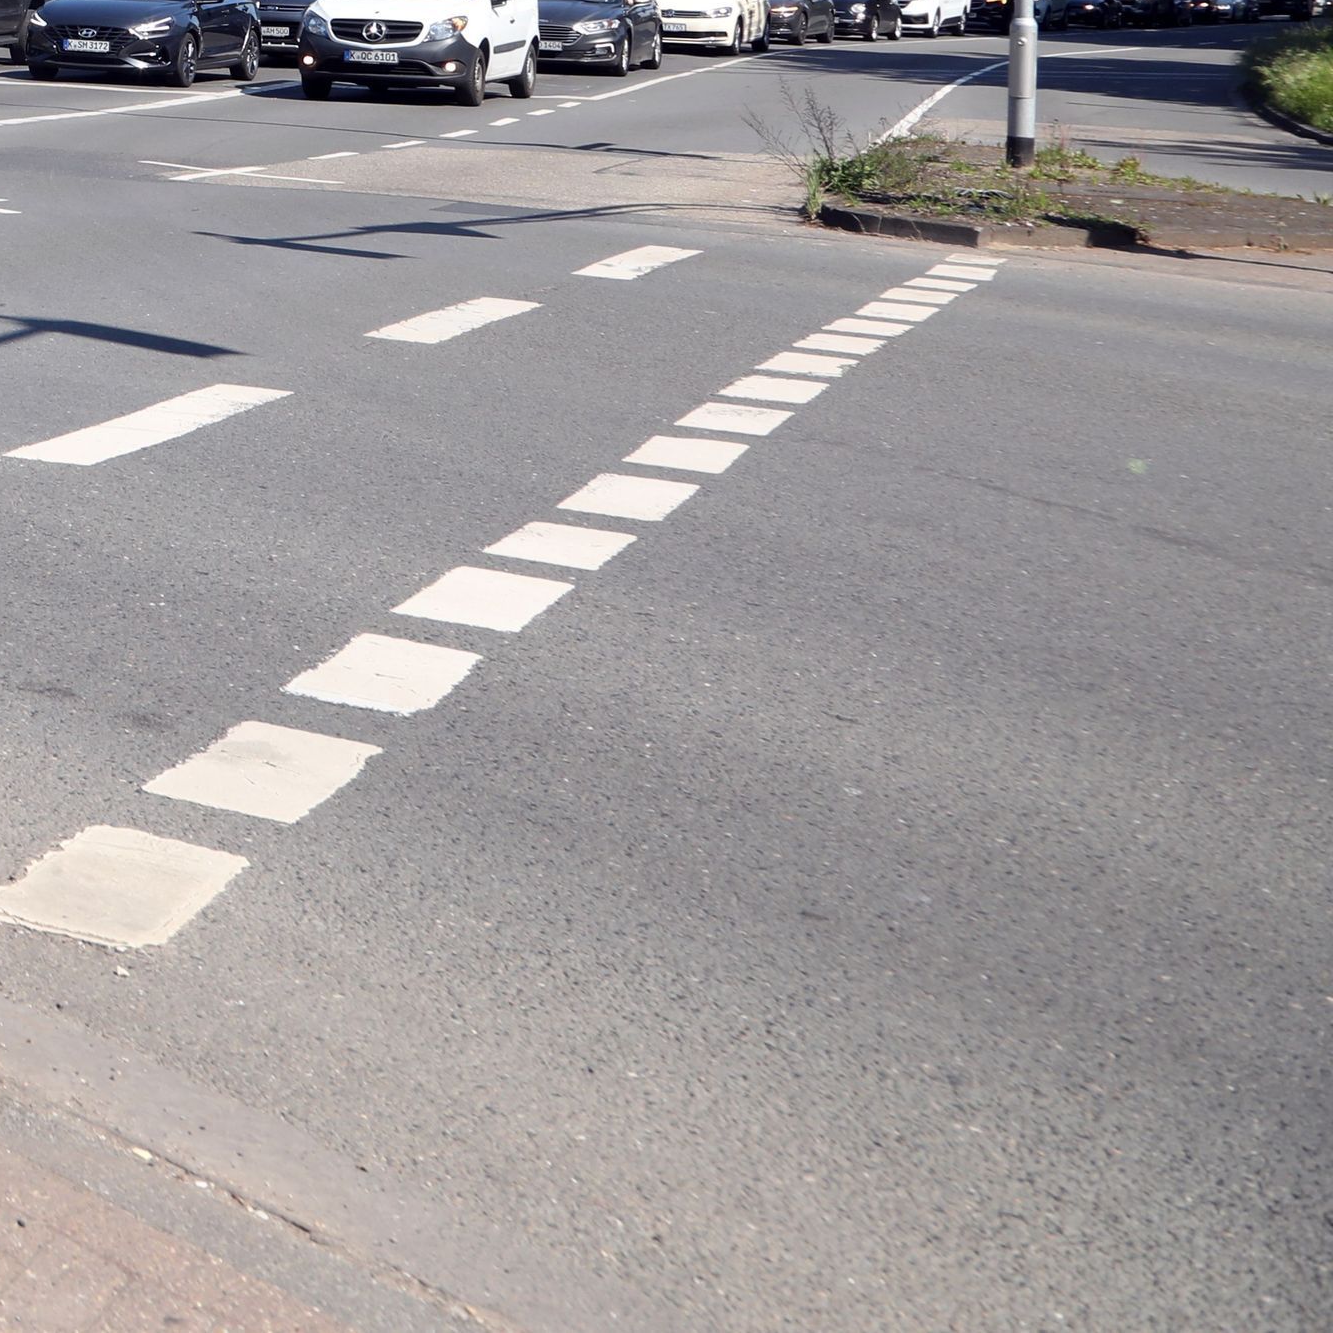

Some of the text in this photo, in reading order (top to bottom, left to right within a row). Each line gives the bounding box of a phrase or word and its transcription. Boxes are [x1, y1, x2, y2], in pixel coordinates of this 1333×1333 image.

[275, 27, 289, 35] 500
[88, 41, 109, 50] 3172
[350, 51, 397, 62] K QC 6101
